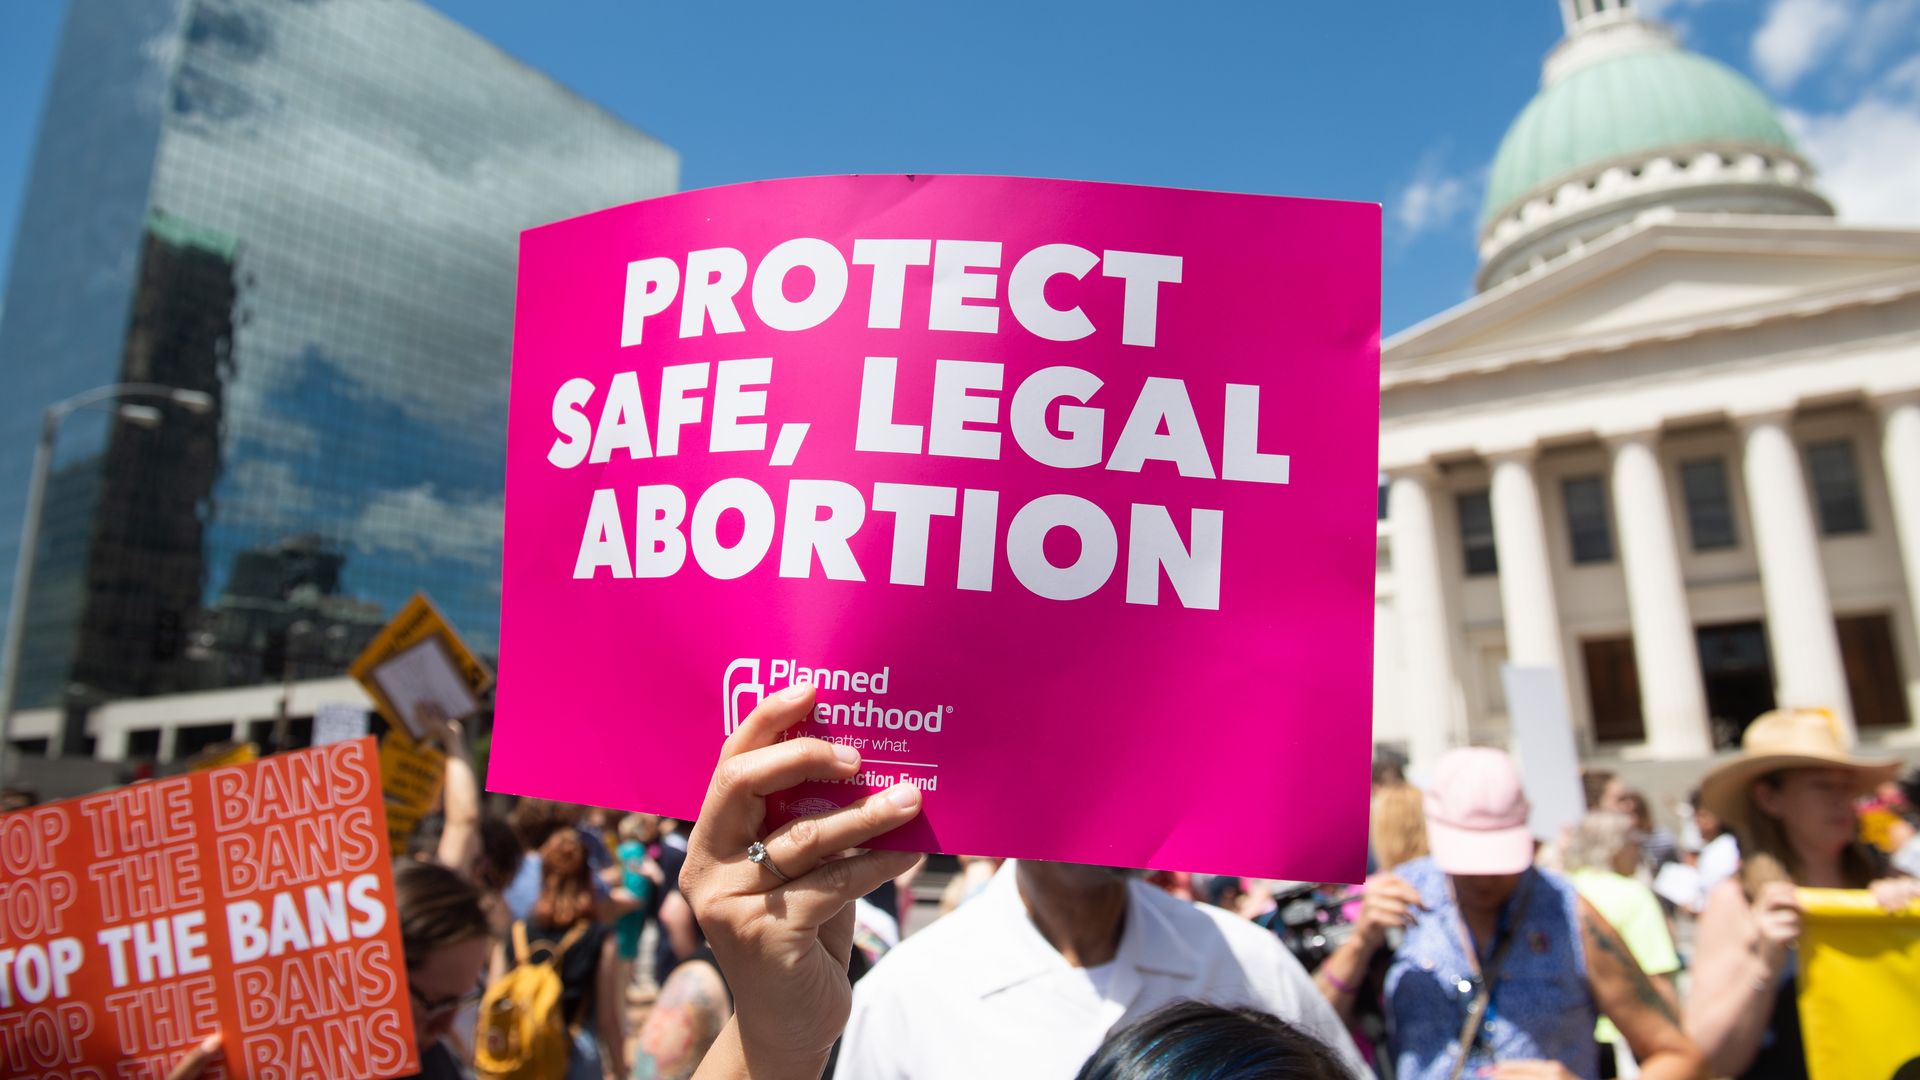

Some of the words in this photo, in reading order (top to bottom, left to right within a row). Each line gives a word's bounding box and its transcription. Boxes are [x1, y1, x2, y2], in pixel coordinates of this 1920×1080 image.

[621, 238, 1182, 347] PROTECT
[547, 357, 811, 468] SAFE,
[855, 357, 1289, 484] LEGAL
[573, 478, 1223, 610] ABORTION
[769, 659, 889, 694] Planned
[871, 736, 911, 753] what.
[0, 806, 71, 877] OP
[81, 776, 197, 858] THE
[209, 741, 371, 833] BANS
[88, 842, 204, 924] THE
[216, 806, 379, 899] BANS
[97, 910, 212, 988] THE
[226, 873, 387, 964] BANS
[0, 1001, 95, 1073] TOP
[105, 975, 223, 1055] THE
[233, 940, 398, 1033] BANS
[243, 1008, 408, 1080] BANS
